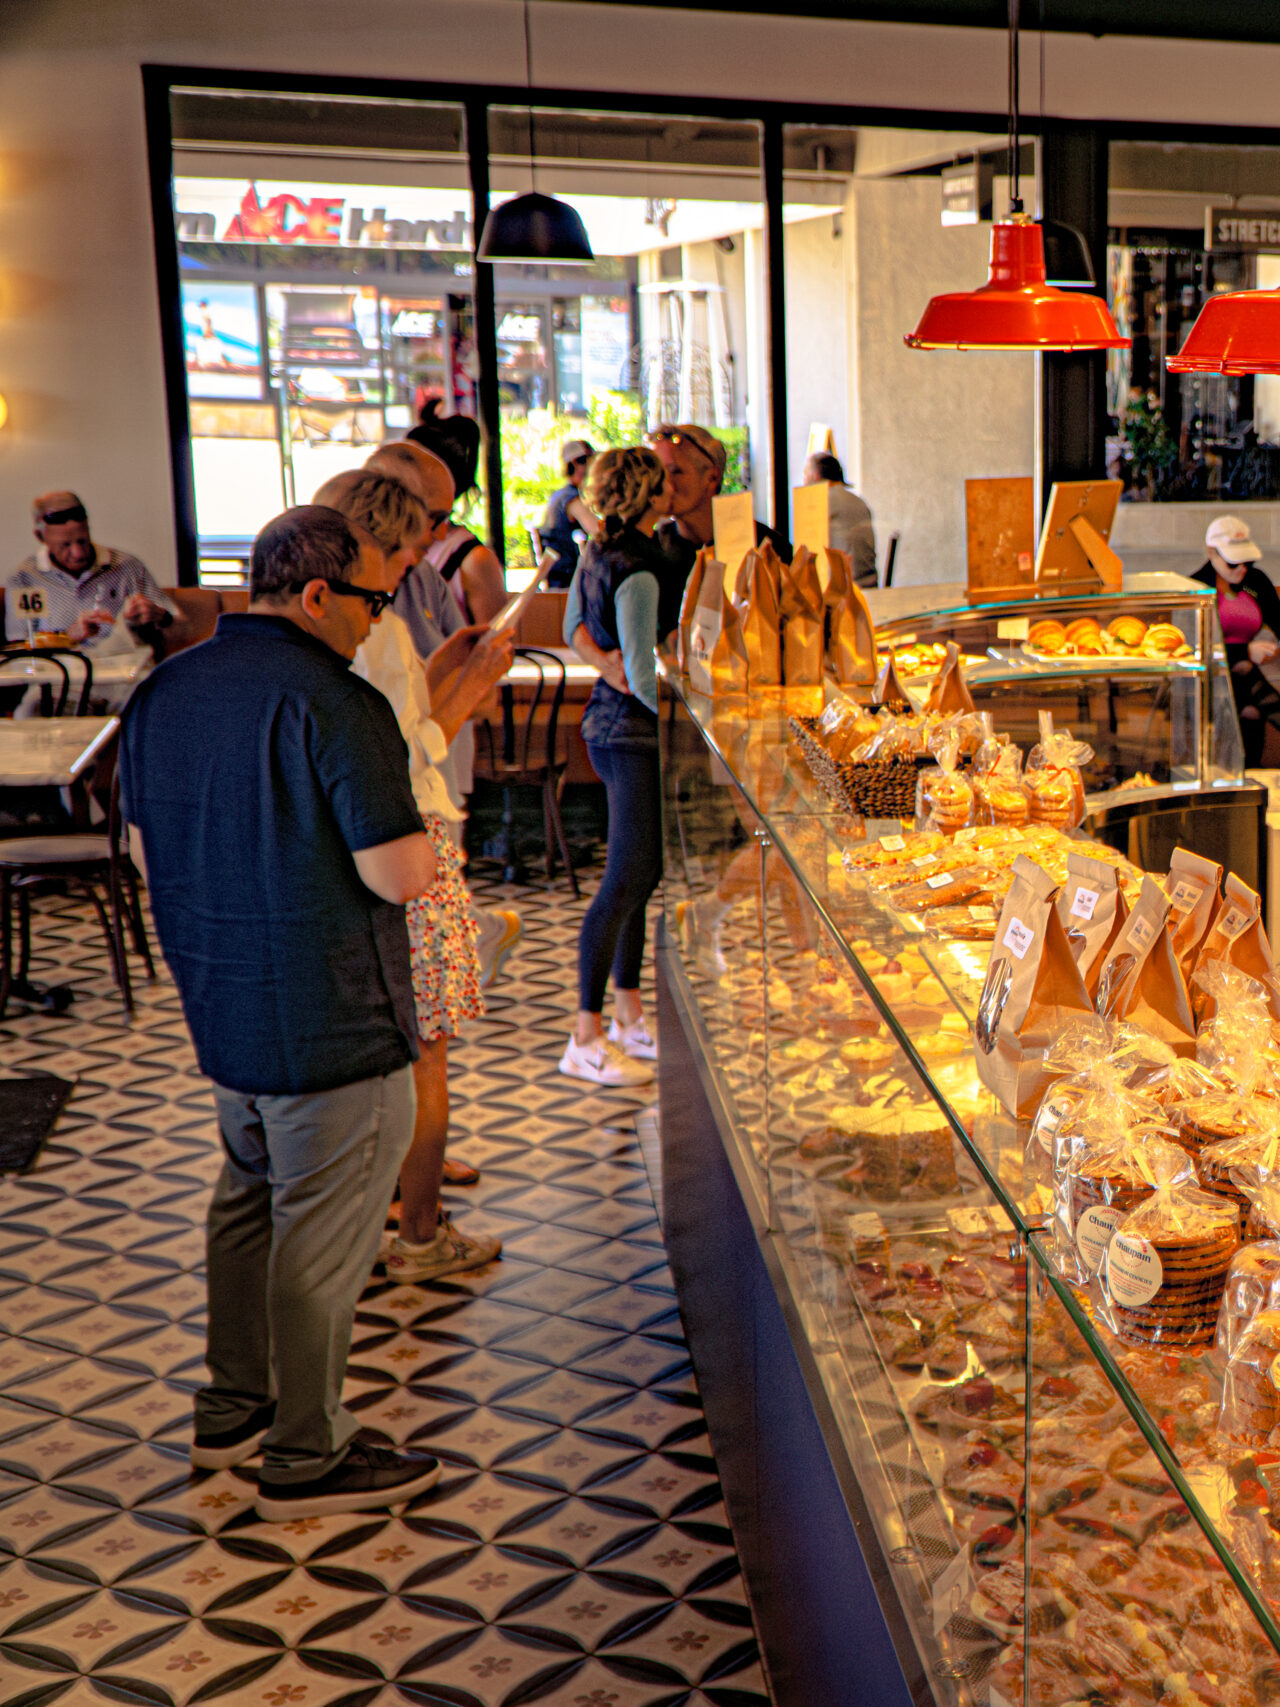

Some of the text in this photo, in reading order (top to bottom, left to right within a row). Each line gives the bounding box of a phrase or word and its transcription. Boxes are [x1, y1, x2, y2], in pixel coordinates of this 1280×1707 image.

[222, 179, 345, 244] ACE
[349, 207, 472, 247] Hard
[19, 593, 43, 612] 46
